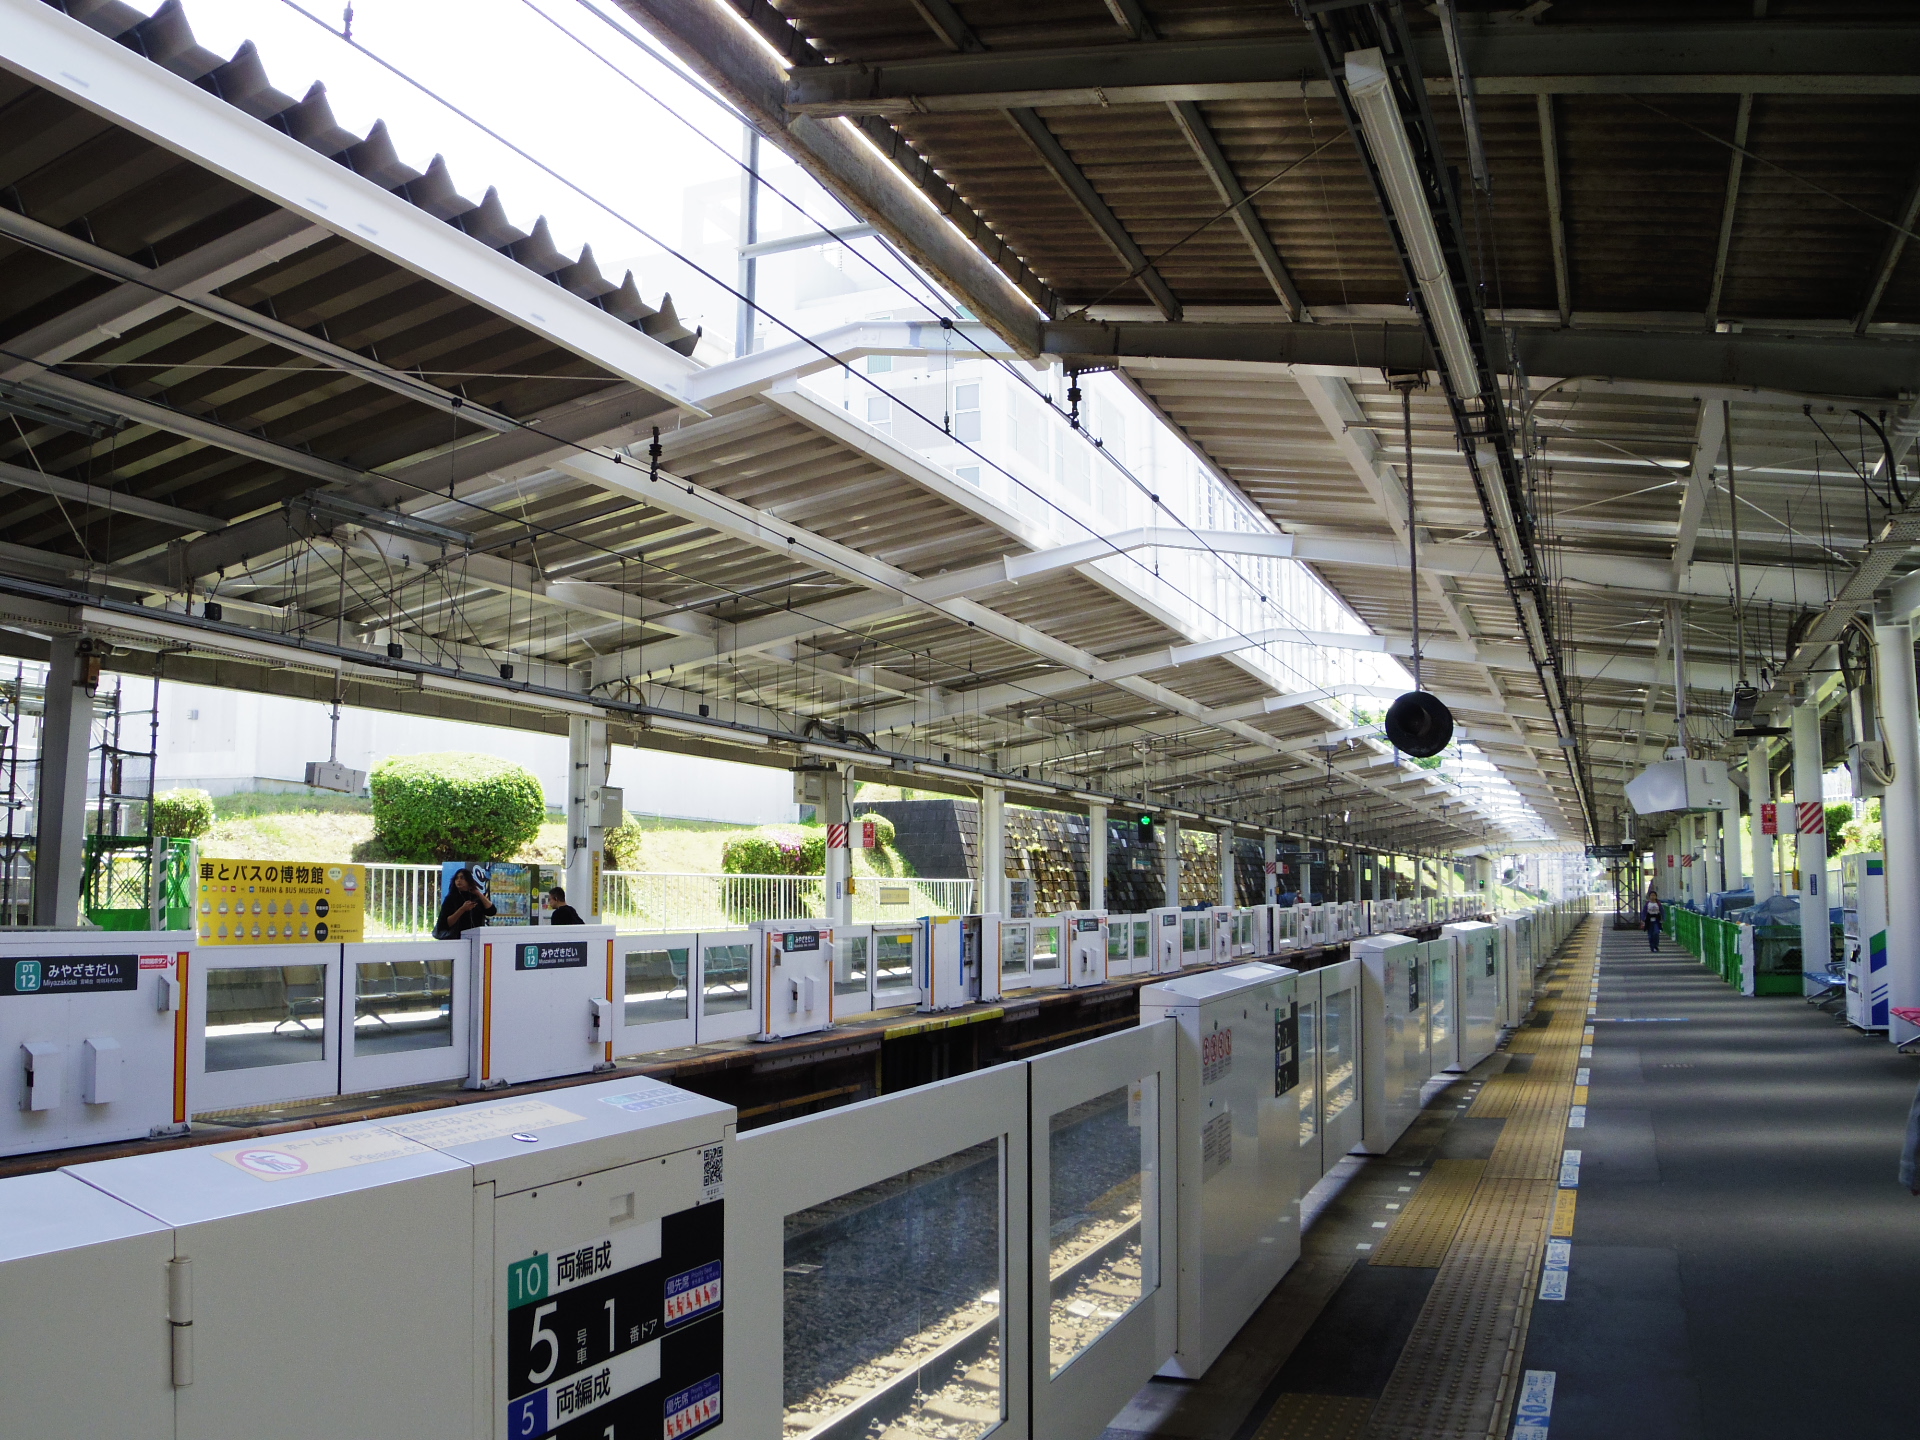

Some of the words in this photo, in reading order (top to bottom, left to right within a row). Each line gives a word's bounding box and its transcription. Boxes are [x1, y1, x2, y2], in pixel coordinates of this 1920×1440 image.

[1587, 847, 1594, 855] 2
[200, 863, 324, 884] 車とバスの博物館
[285, 886, 297, 894] BUS
[541, 947, 578, 958] みやざきだい
[527, 955, 536, 965] 12
[22, 964, 34, 973] DT
[48, 963, 119, 978] みやざきだい
[20, 974, 36, 988] 12
[42, 978, 78, 988] Miyazakidai
[350, 1149, 403, 1162] Please
[516, 1263, 541, 1300] 10
[557, 1241, 611, 1286] 両編成
[527, 1301, 559, 1384] 5
[603, 1298, 615, 1353] 1
[629, 1318, 658, 1344] 番ドア
[521, 1401, 534, 1436] 5
[556, 1368, 611, 1419] 両編成
